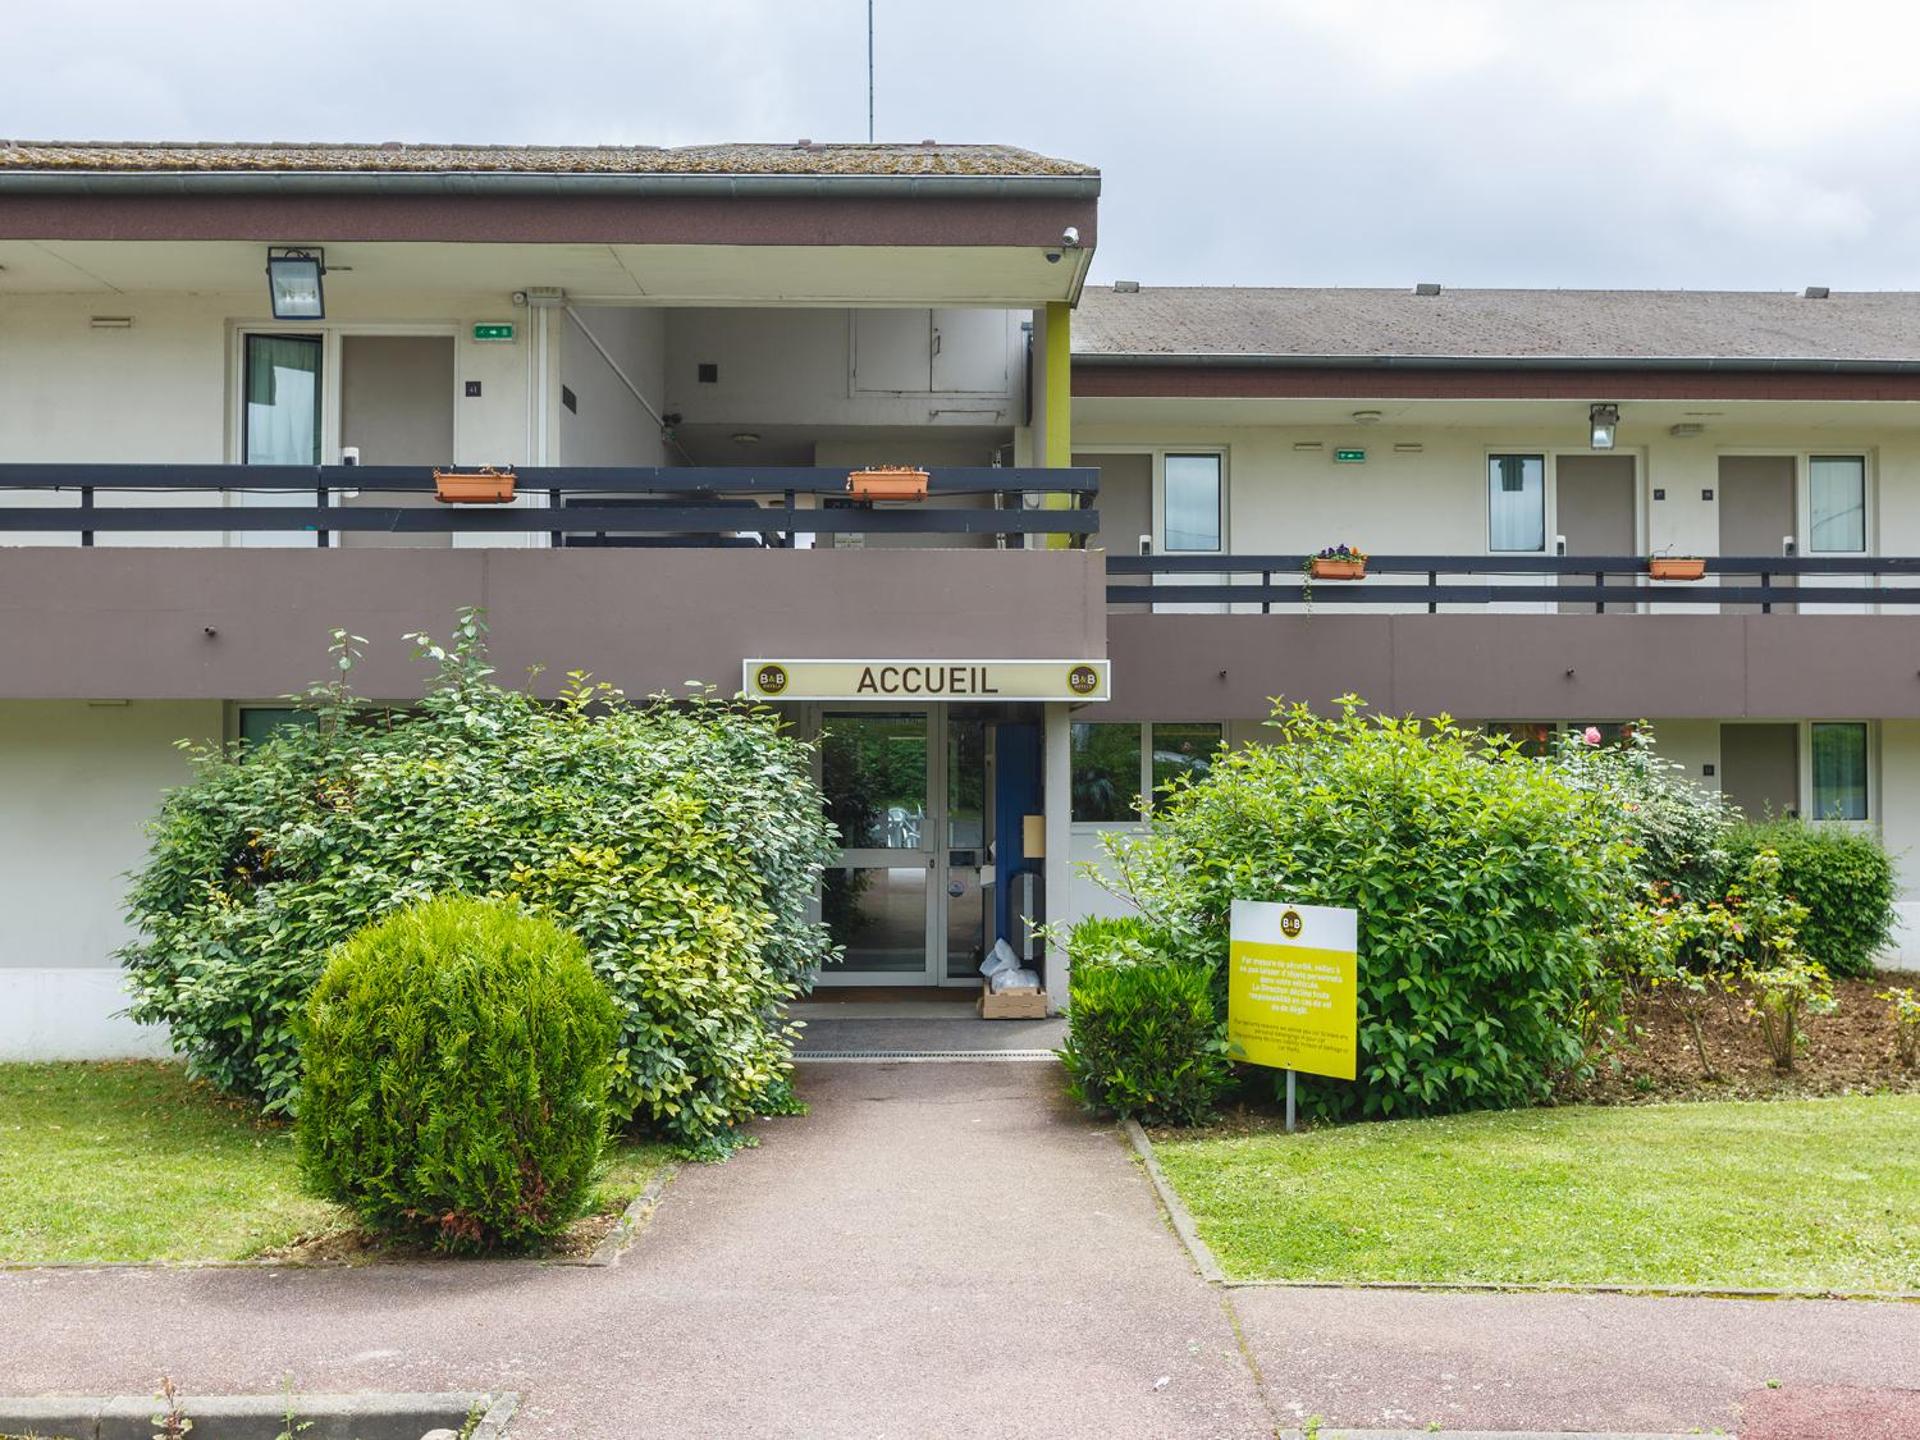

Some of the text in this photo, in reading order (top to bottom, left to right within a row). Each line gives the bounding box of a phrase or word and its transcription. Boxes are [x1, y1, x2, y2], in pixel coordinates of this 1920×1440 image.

[760, 673, 784, 684] B&B
[857, 667, 998, 693] ACCUEIL
[1072, 674, 1095, 685] B&B
